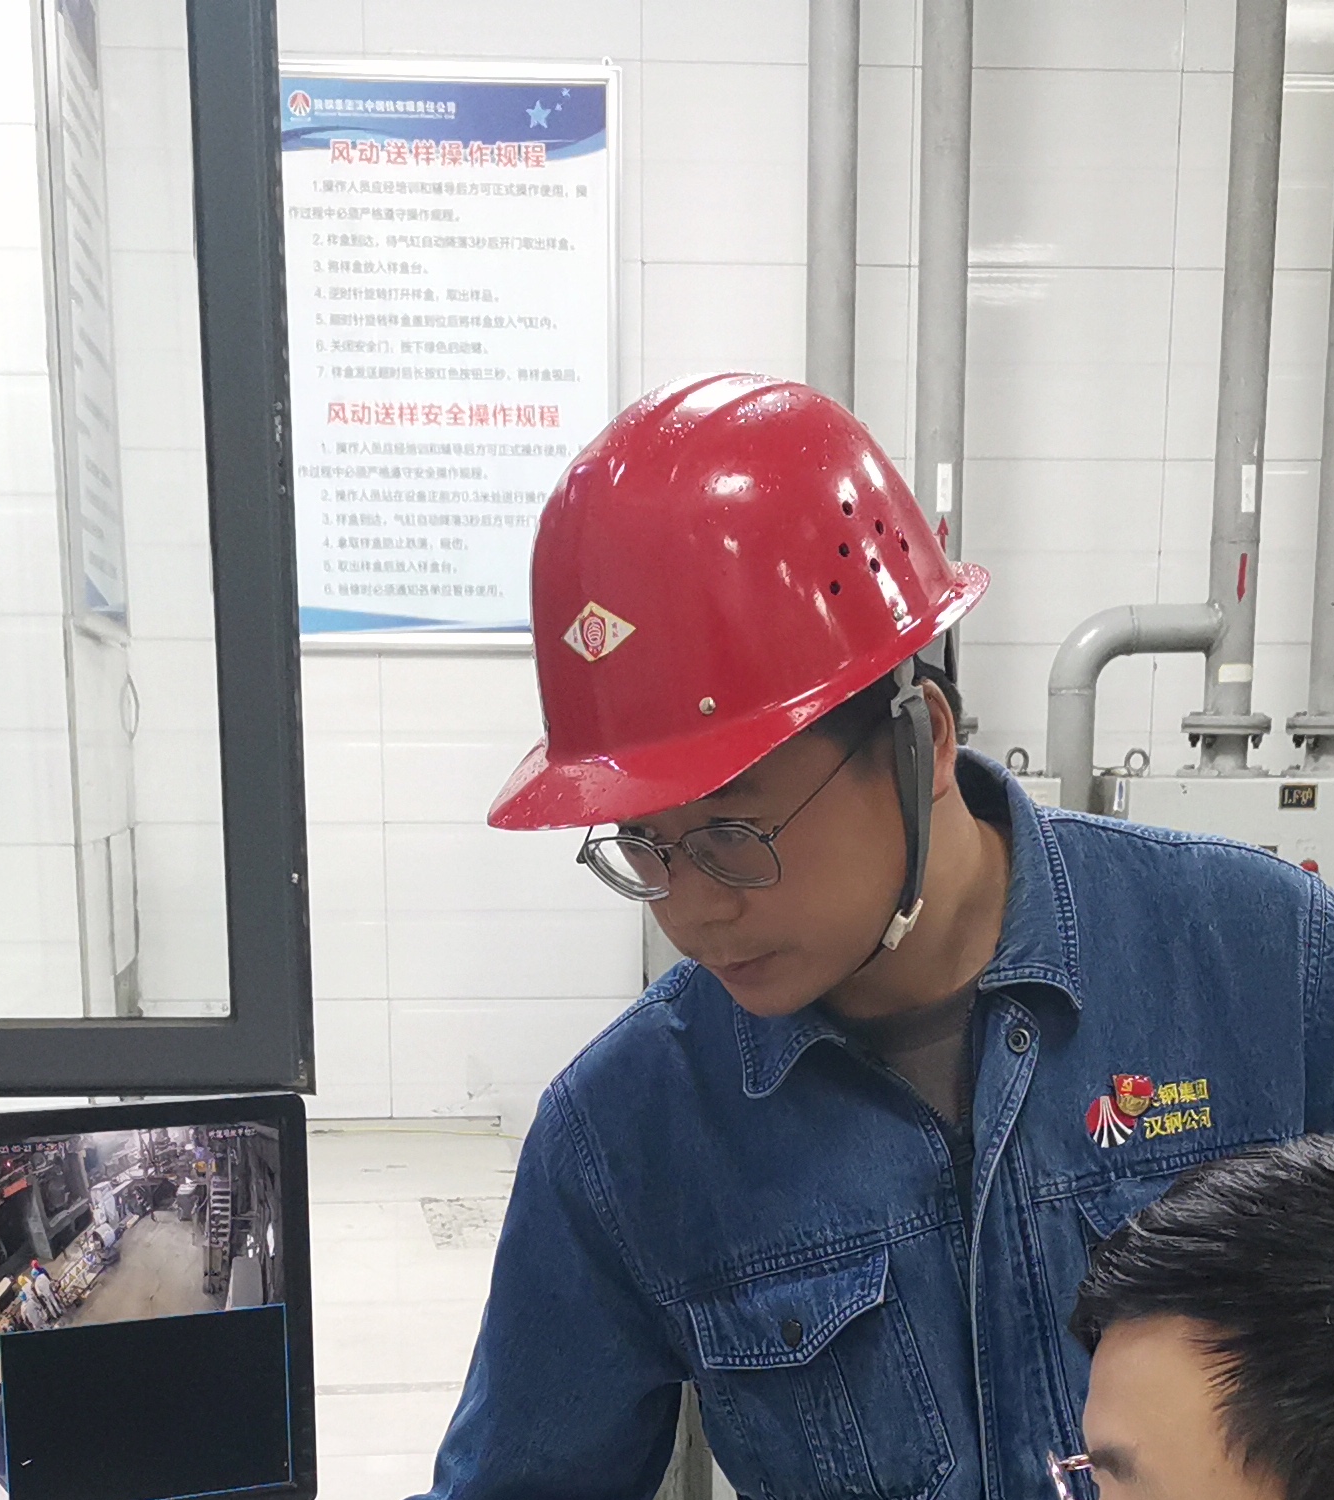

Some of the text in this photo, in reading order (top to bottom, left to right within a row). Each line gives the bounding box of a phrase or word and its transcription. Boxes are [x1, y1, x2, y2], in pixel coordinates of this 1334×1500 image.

[329, 138, 547, 169] 风动送样操作规程
[327, 402, 561, 429] 风动送样安全操作规程
[1151, 1078, 1209, 1107] 钢集团
[1144, 1107, 1213, 1139] 汉钢公司
